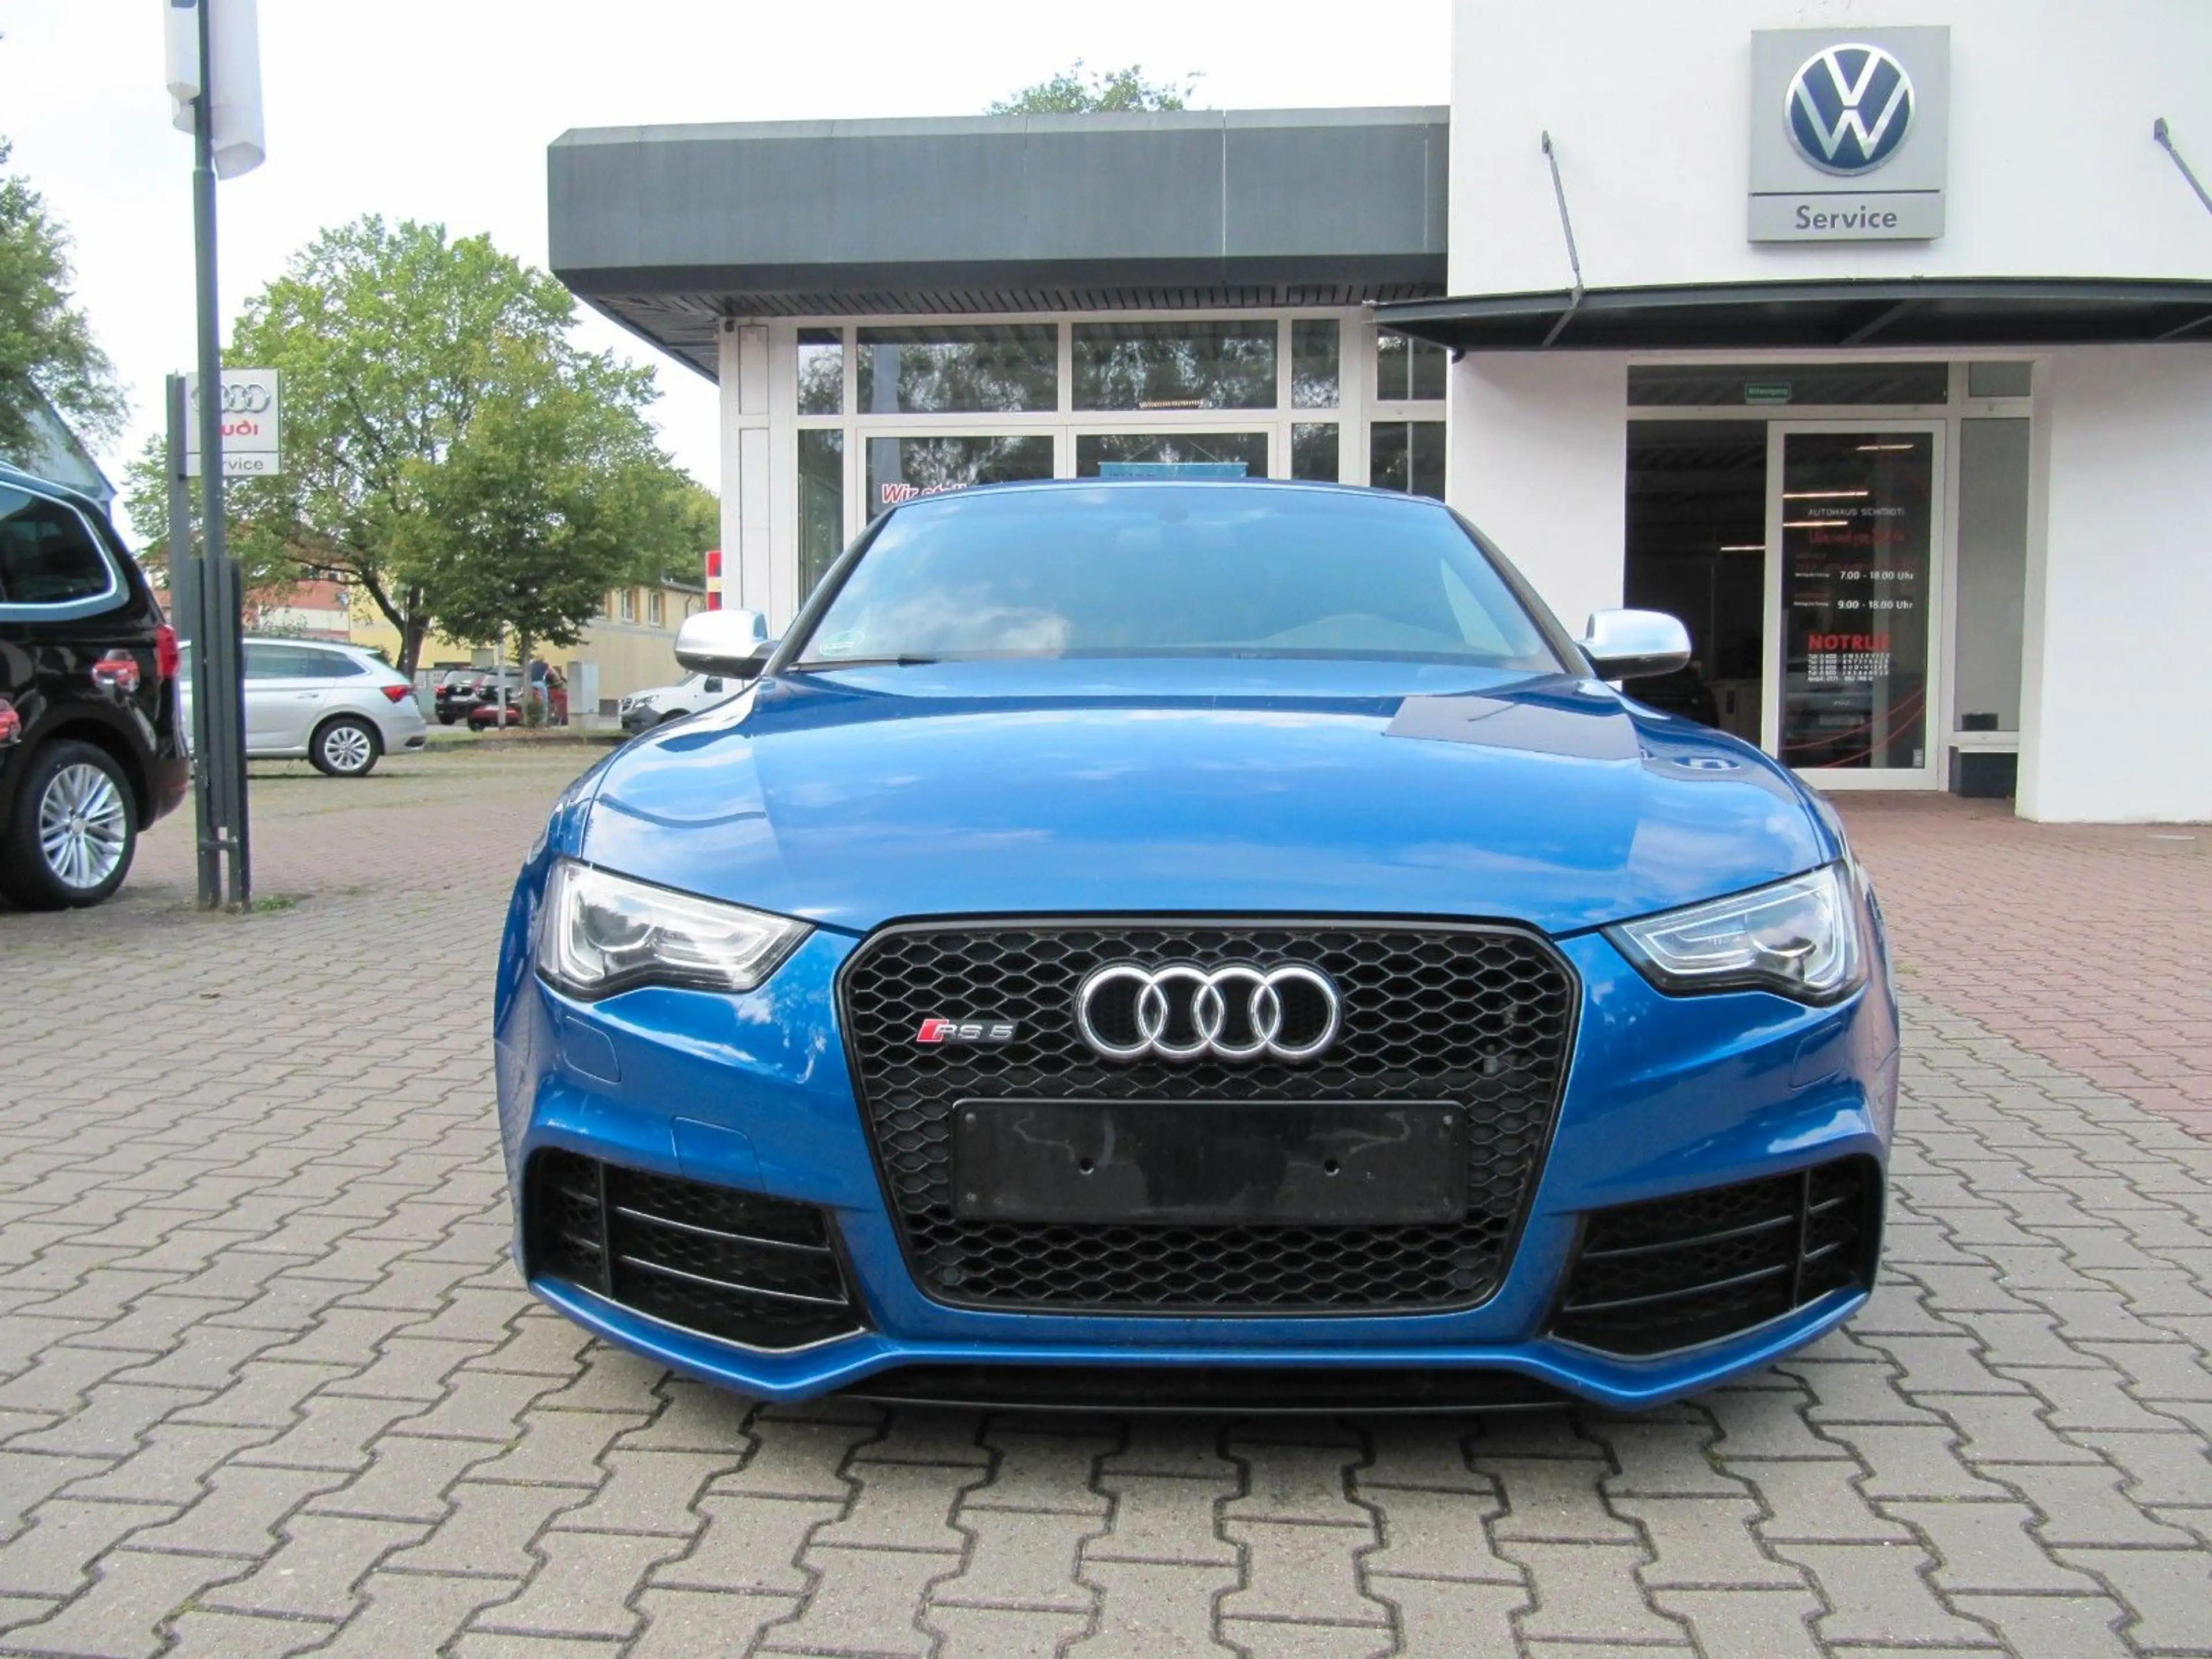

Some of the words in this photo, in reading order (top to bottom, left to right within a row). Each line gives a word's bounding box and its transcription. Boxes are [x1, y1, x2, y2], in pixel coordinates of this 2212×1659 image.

[1795, 204, 1897, 230] Service
[219, 421, 258, 436] udi
[223, 457, 264, 471] vice
[1897, 570, 1914, 580] Uhr
[1837, 600, 1859, 609] 9.00
[1868, 600, 1893, 609] 18.00
[1896, 599, 1913, 609] Uhr
[931, 1024, 983, 1039] RS
